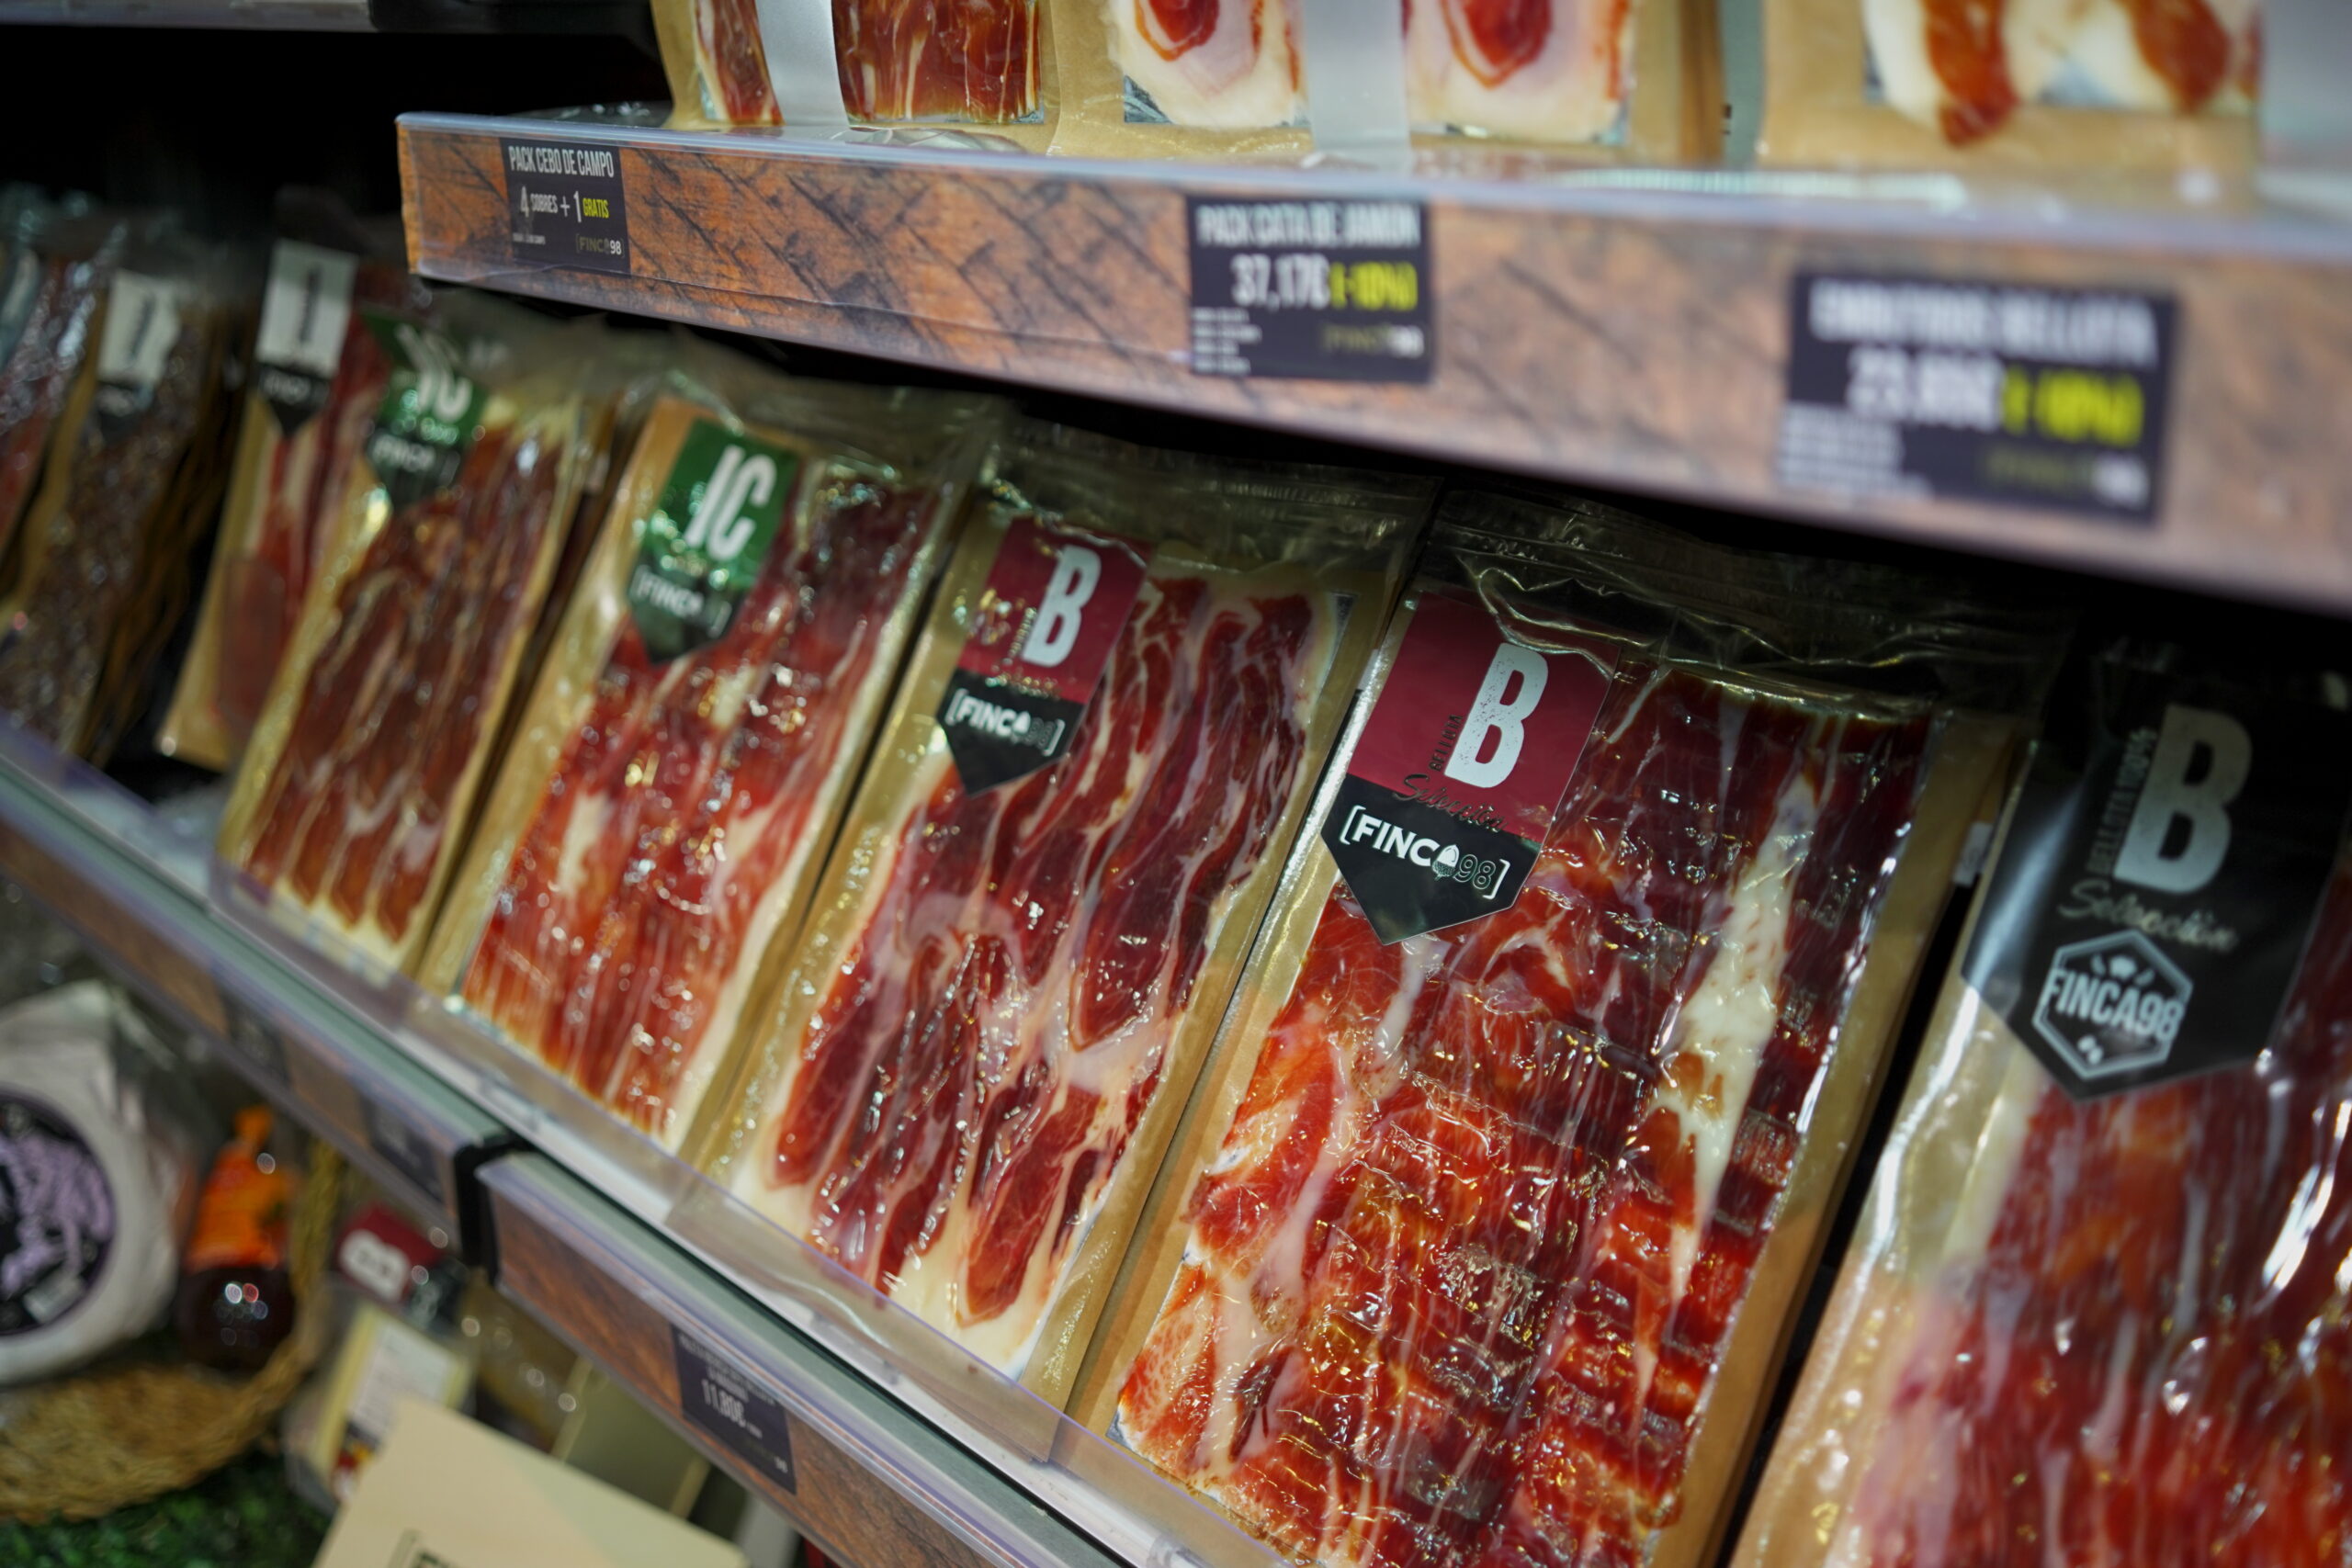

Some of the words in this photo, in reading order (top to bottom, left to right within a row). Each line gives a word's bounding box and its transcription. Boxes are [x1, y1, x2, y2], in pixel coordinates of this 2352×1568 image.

[508, 146, 537, 172] PACK
[536, 147, 562, 174] CEBO
[562, 149, 577, 175] DE
[577, 150, 615, 177] CAMPO
[520, 186, 530, 217] 4
[530, 193, 558, 213] SOBRES
[573, 190, 582, 222] 1
[582, 197, 609, 218] GRATIS
[1020, 544, 1102, 667] B
[1443, 642, 1548, 788] B
[2115, 702, 2253, 895] B
[2047, 967, 2185, 1043] FINCA98
